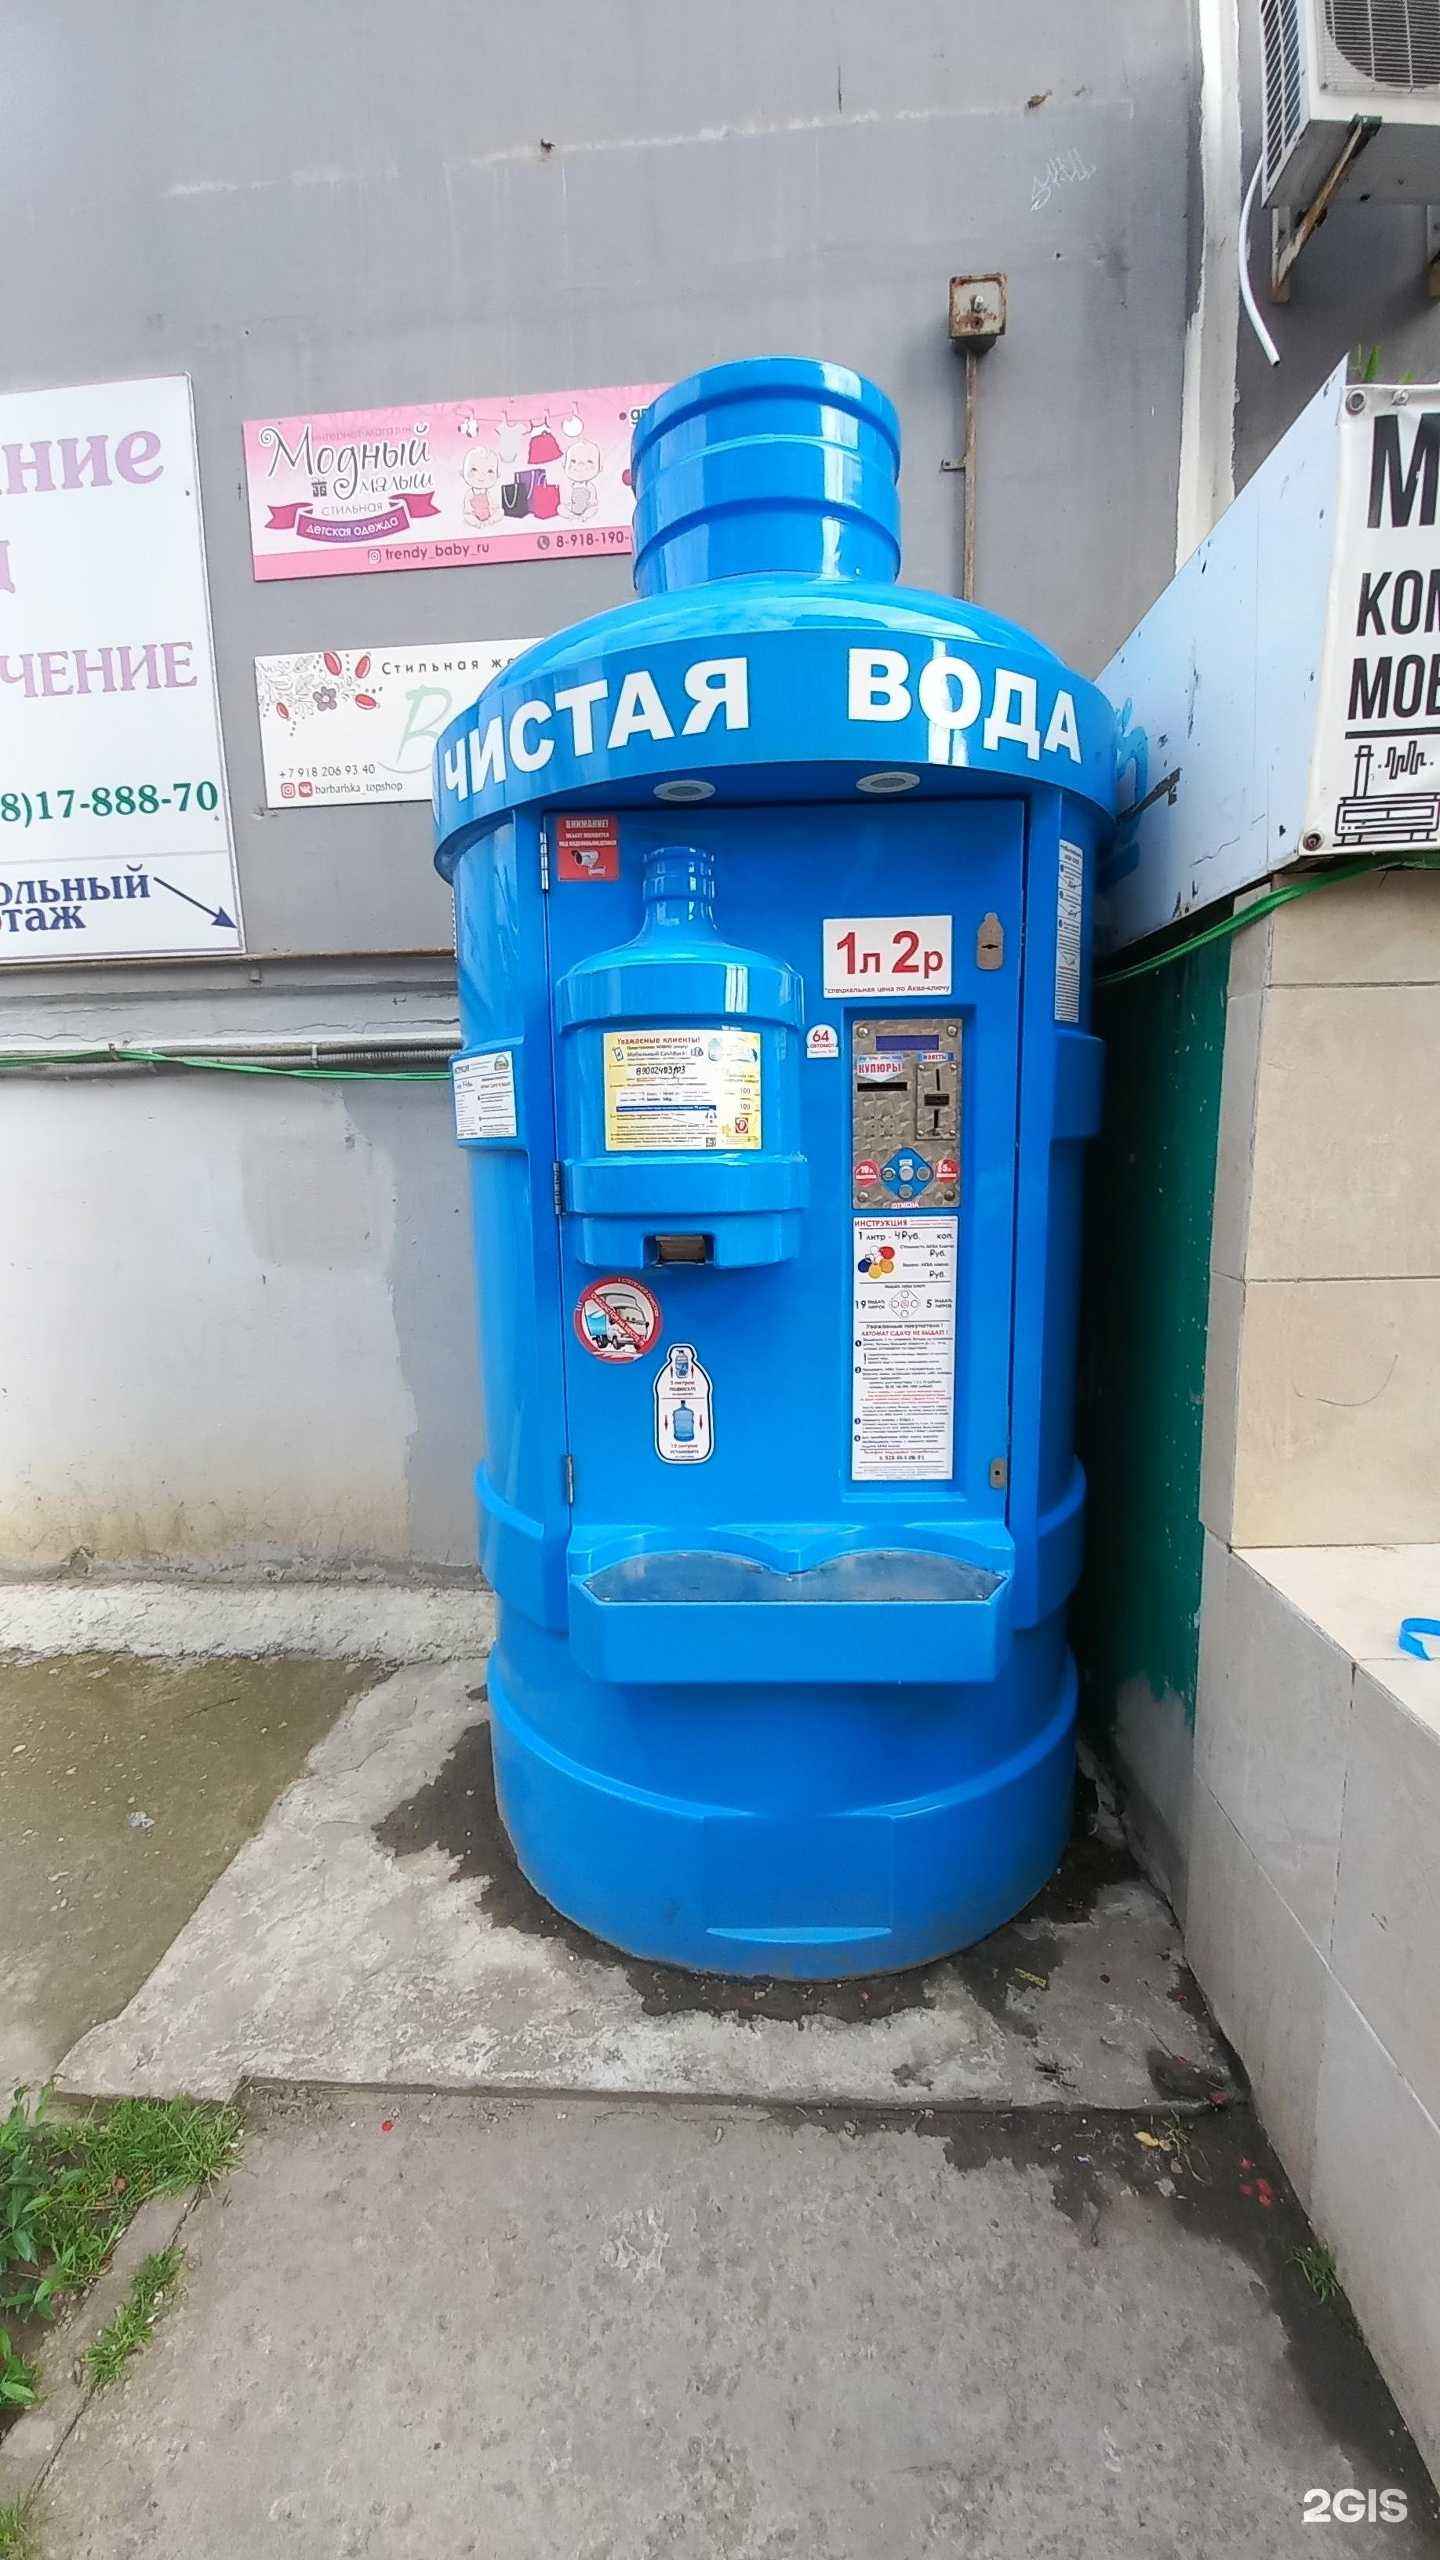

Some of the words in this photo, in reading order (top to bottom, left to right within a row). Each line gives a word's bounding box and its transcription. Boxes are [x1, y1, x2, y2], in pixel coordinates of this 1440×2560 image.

[0, 431, 163, 495] ние
[260, 424, 430, 500] Модный
[385, 541, 490, 562] trendy_baby_ru
[556, 529, 632, 548] 8-918-190-
[382, 659, 479, 675] Стильная
[442, 656, 750, 801] ЧИСТАЯ
[848, 648, 1083, 764] ВОДА
[0, 905, 87, 933] таж
[837, 931, 881, 975] 1л
[891, 930, 944, 979] 2р
[812, 1030, 830, 1043] 64
